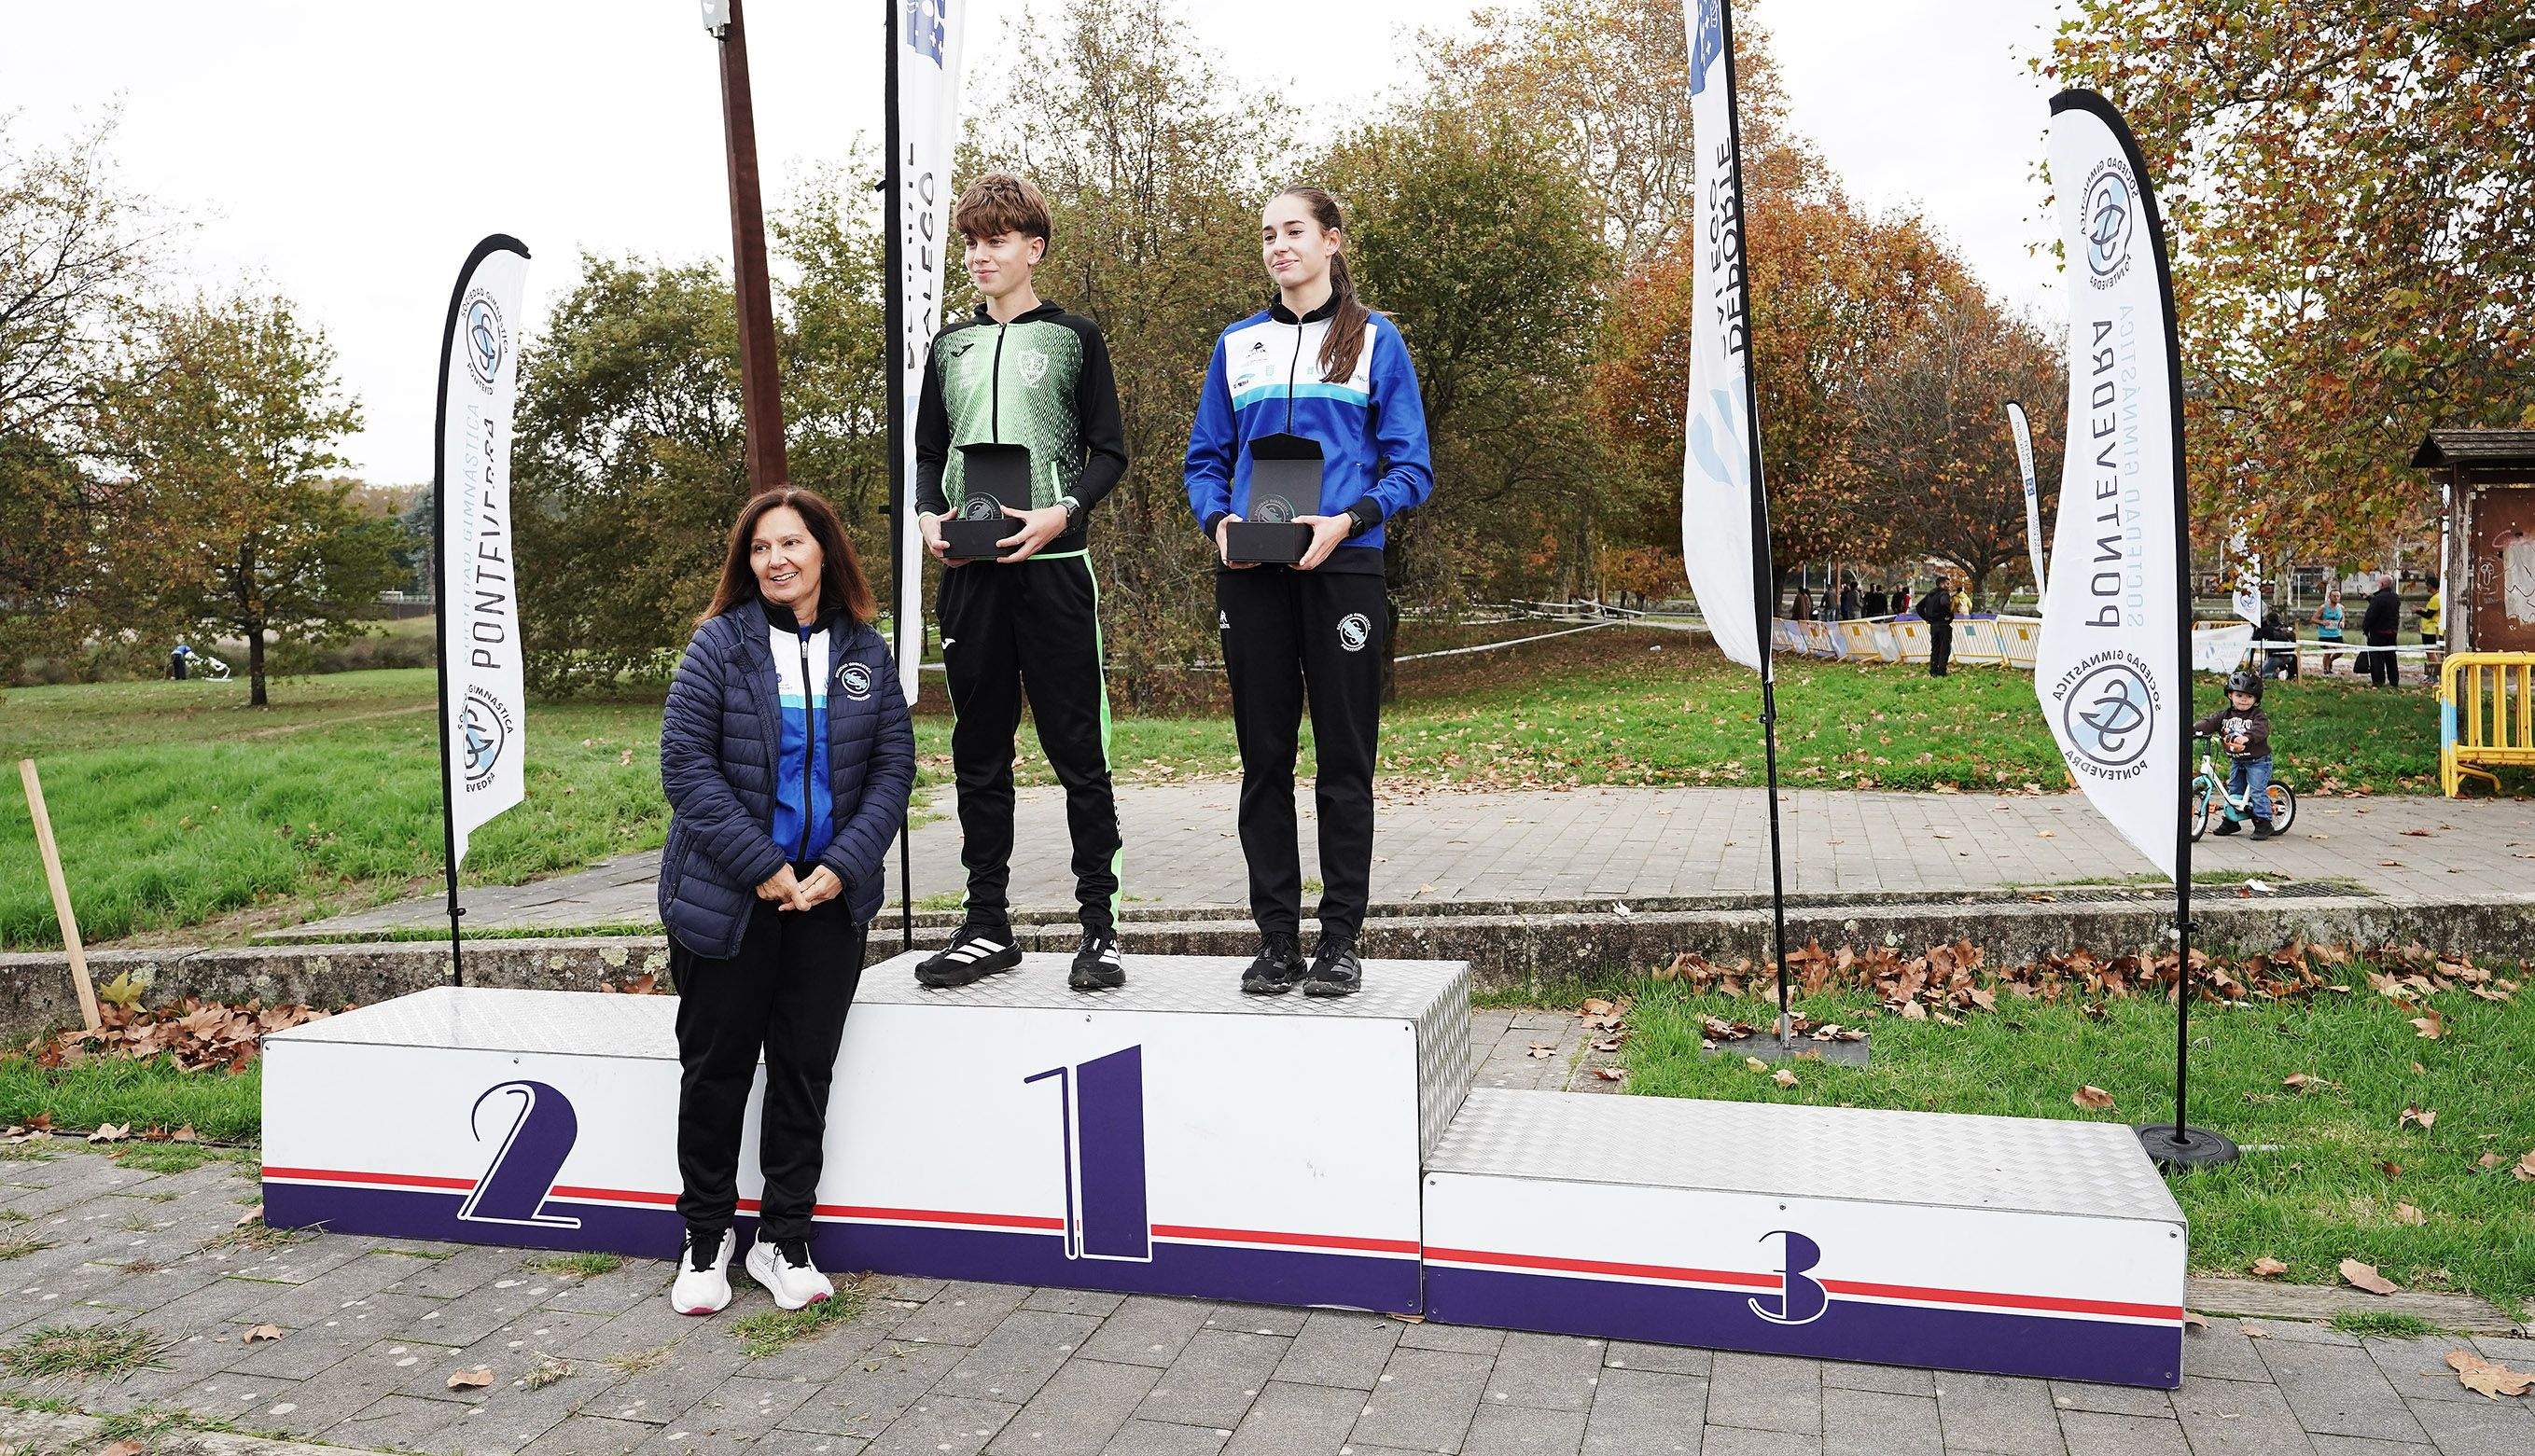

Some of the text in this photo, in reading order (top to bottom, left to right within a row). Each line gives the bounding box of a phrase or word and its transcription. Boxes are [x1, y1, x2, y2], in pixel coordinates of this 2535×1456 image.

[462, 403, 481, 542] GIMNÁSTICA
[467, 684, 514, 734] GIMNÁSTICA
[456, 1079, 582, 1229] 2
[1024, 1043, 1152, 1263] 1
[1747, 1229, 1831, 1326] 3
